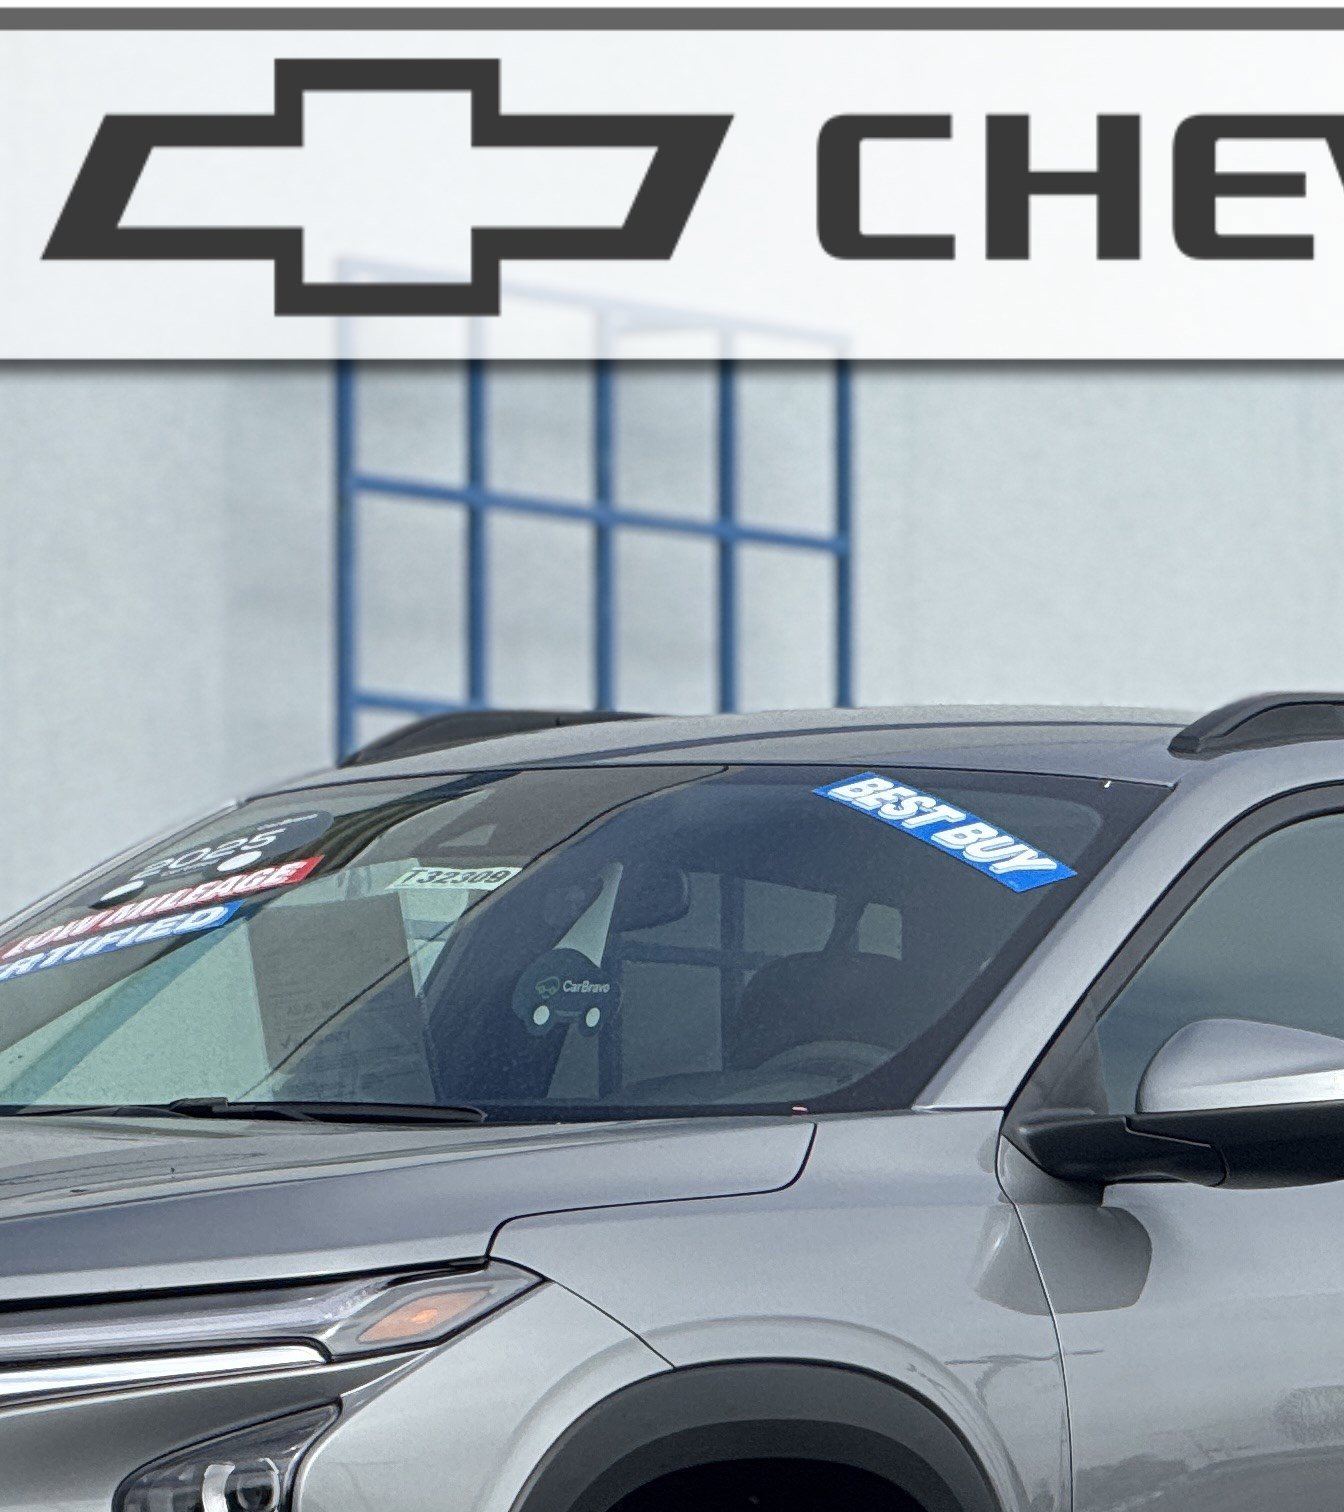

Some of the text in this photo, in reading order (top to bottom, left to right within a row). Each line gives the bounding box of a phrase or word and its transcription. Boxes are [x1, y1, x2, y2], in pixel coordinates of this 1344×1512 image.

[130, 828, 286, 881] 2025
[828, 777, 1058, 875] BEST BUY
[2, 858, 308, 960] LOW MILEAGE
[562, 980, 611, 993] CarBravo
